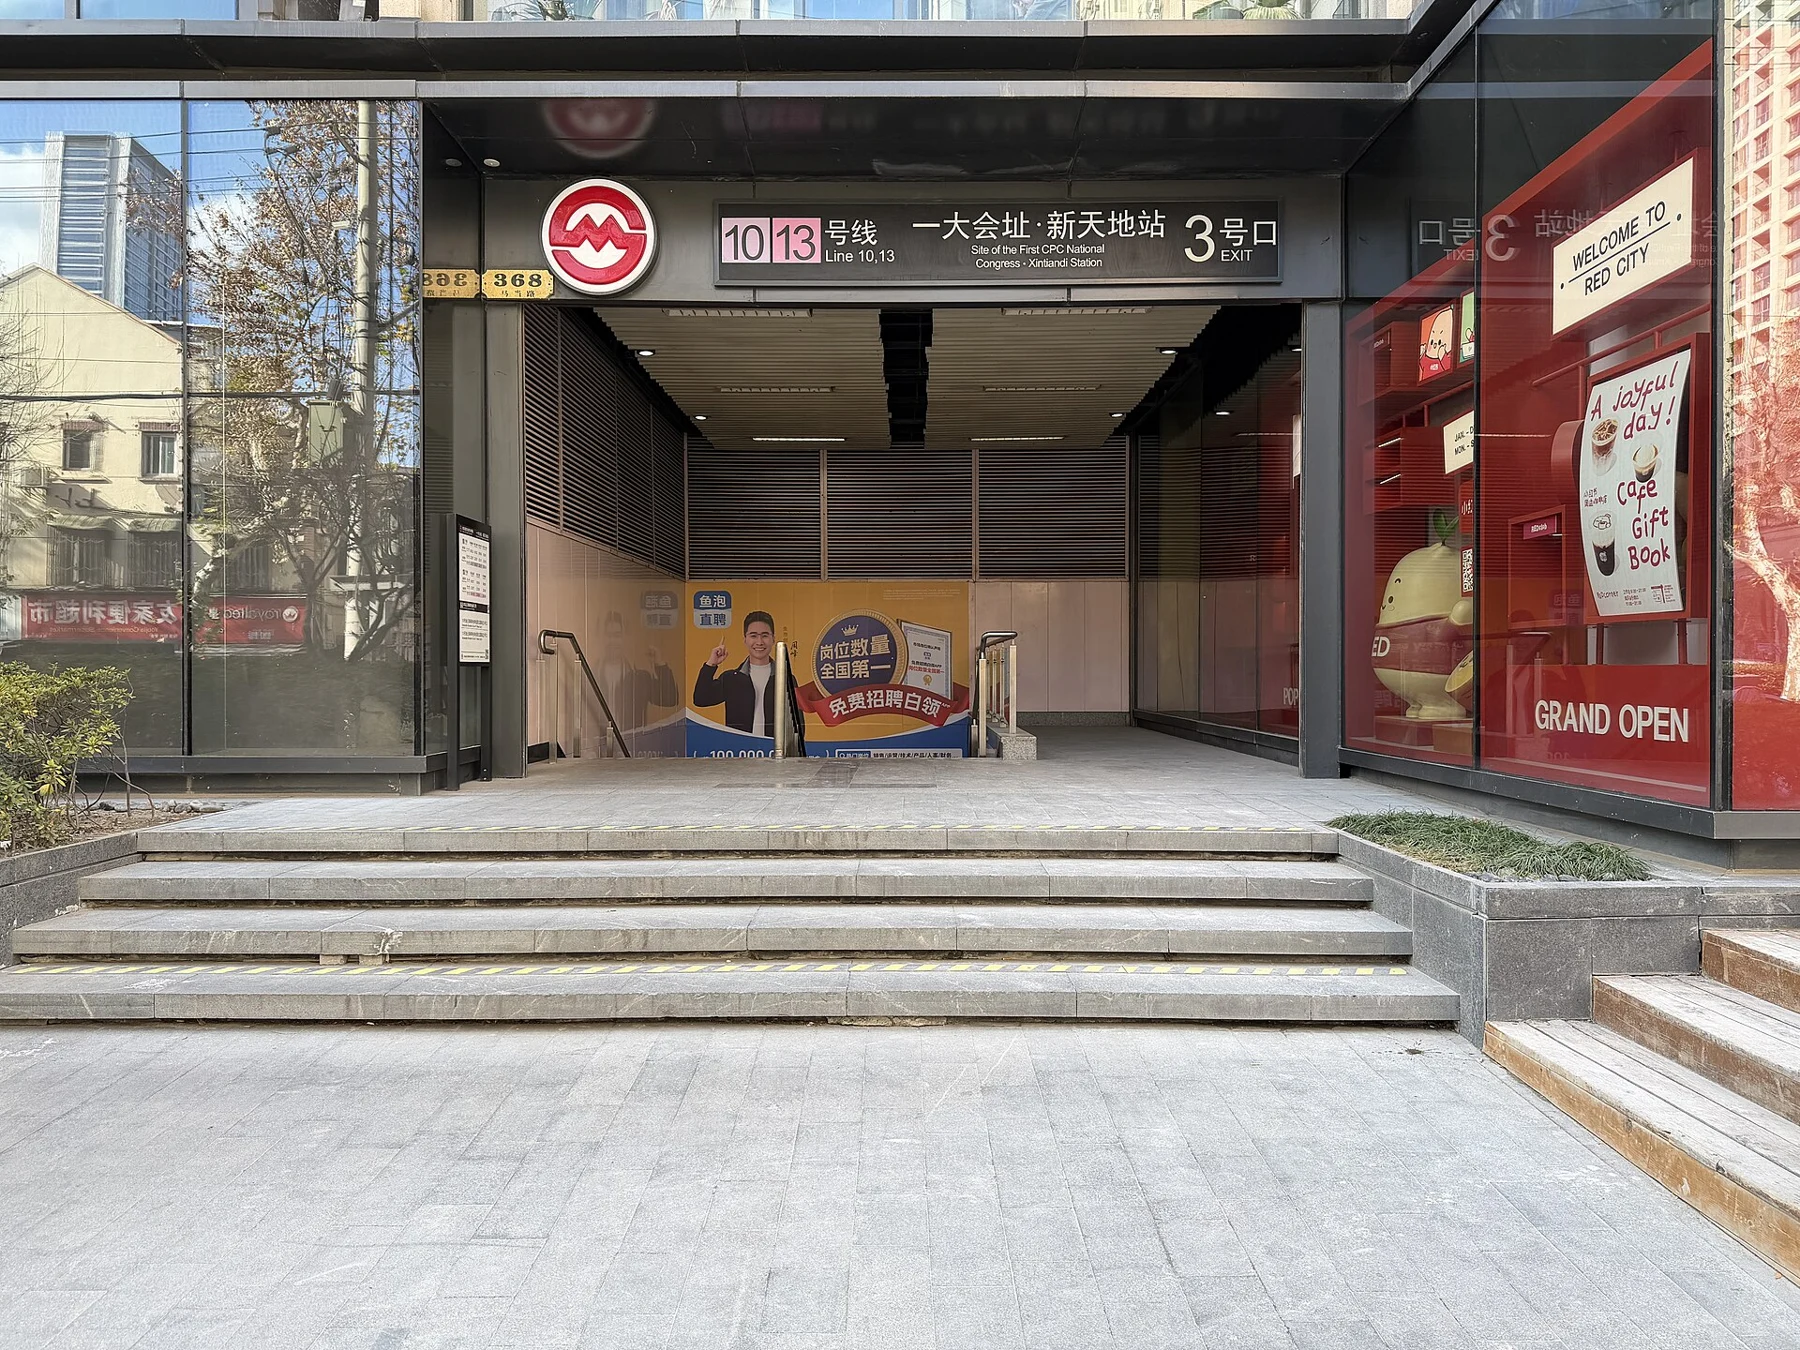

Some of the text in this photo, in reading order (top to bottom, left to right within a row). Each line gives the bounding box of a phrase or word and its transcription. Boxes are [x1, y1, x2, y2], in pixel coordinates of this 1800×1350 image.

[912, 209, 1166, 240] 一大会址·新天地站
[1184, 215, 1215, 263] 3
[1219, 218, 1277, 247] 号口
[1573, 215, 1640, 271] WELCOME
[1646, 200, 1666, 227] TO
[724, 219, 878, 261] 10 13 号线
[970, 243, 1105, 255] Site of the First CPC National
[825, 249, 896, 264] Line 10,13
[975, 258, 1021, 270] Congress
[1028, 257, 1068, 268] Xintiandi
[1069, 257, 1103, 268] Station
[1220, 249, 1253, 262] EXIT
[1584, 243, 1651, 297] RED CITY
[494, 273, 542, 287] 368
[1590, 361, 1680, 422] A joyful
[1623, 396, 1676, 441] day!
[1616, 478, 1658, 514] Cafe
[1632, 506, 1670, 540] Gift
[1627, 538, 1671, 571] Book
[699, 595, 727, 608] 鱼泡
[699, 613, 726, 626] 直聘
[820, 634, 891, 661] 岗位数量
[820, 659, 891, 680] 全国第一
[828, 689, 942, 719] 免费招聘白领
[1535, 699, 1689, 743] GRAND OPEN
